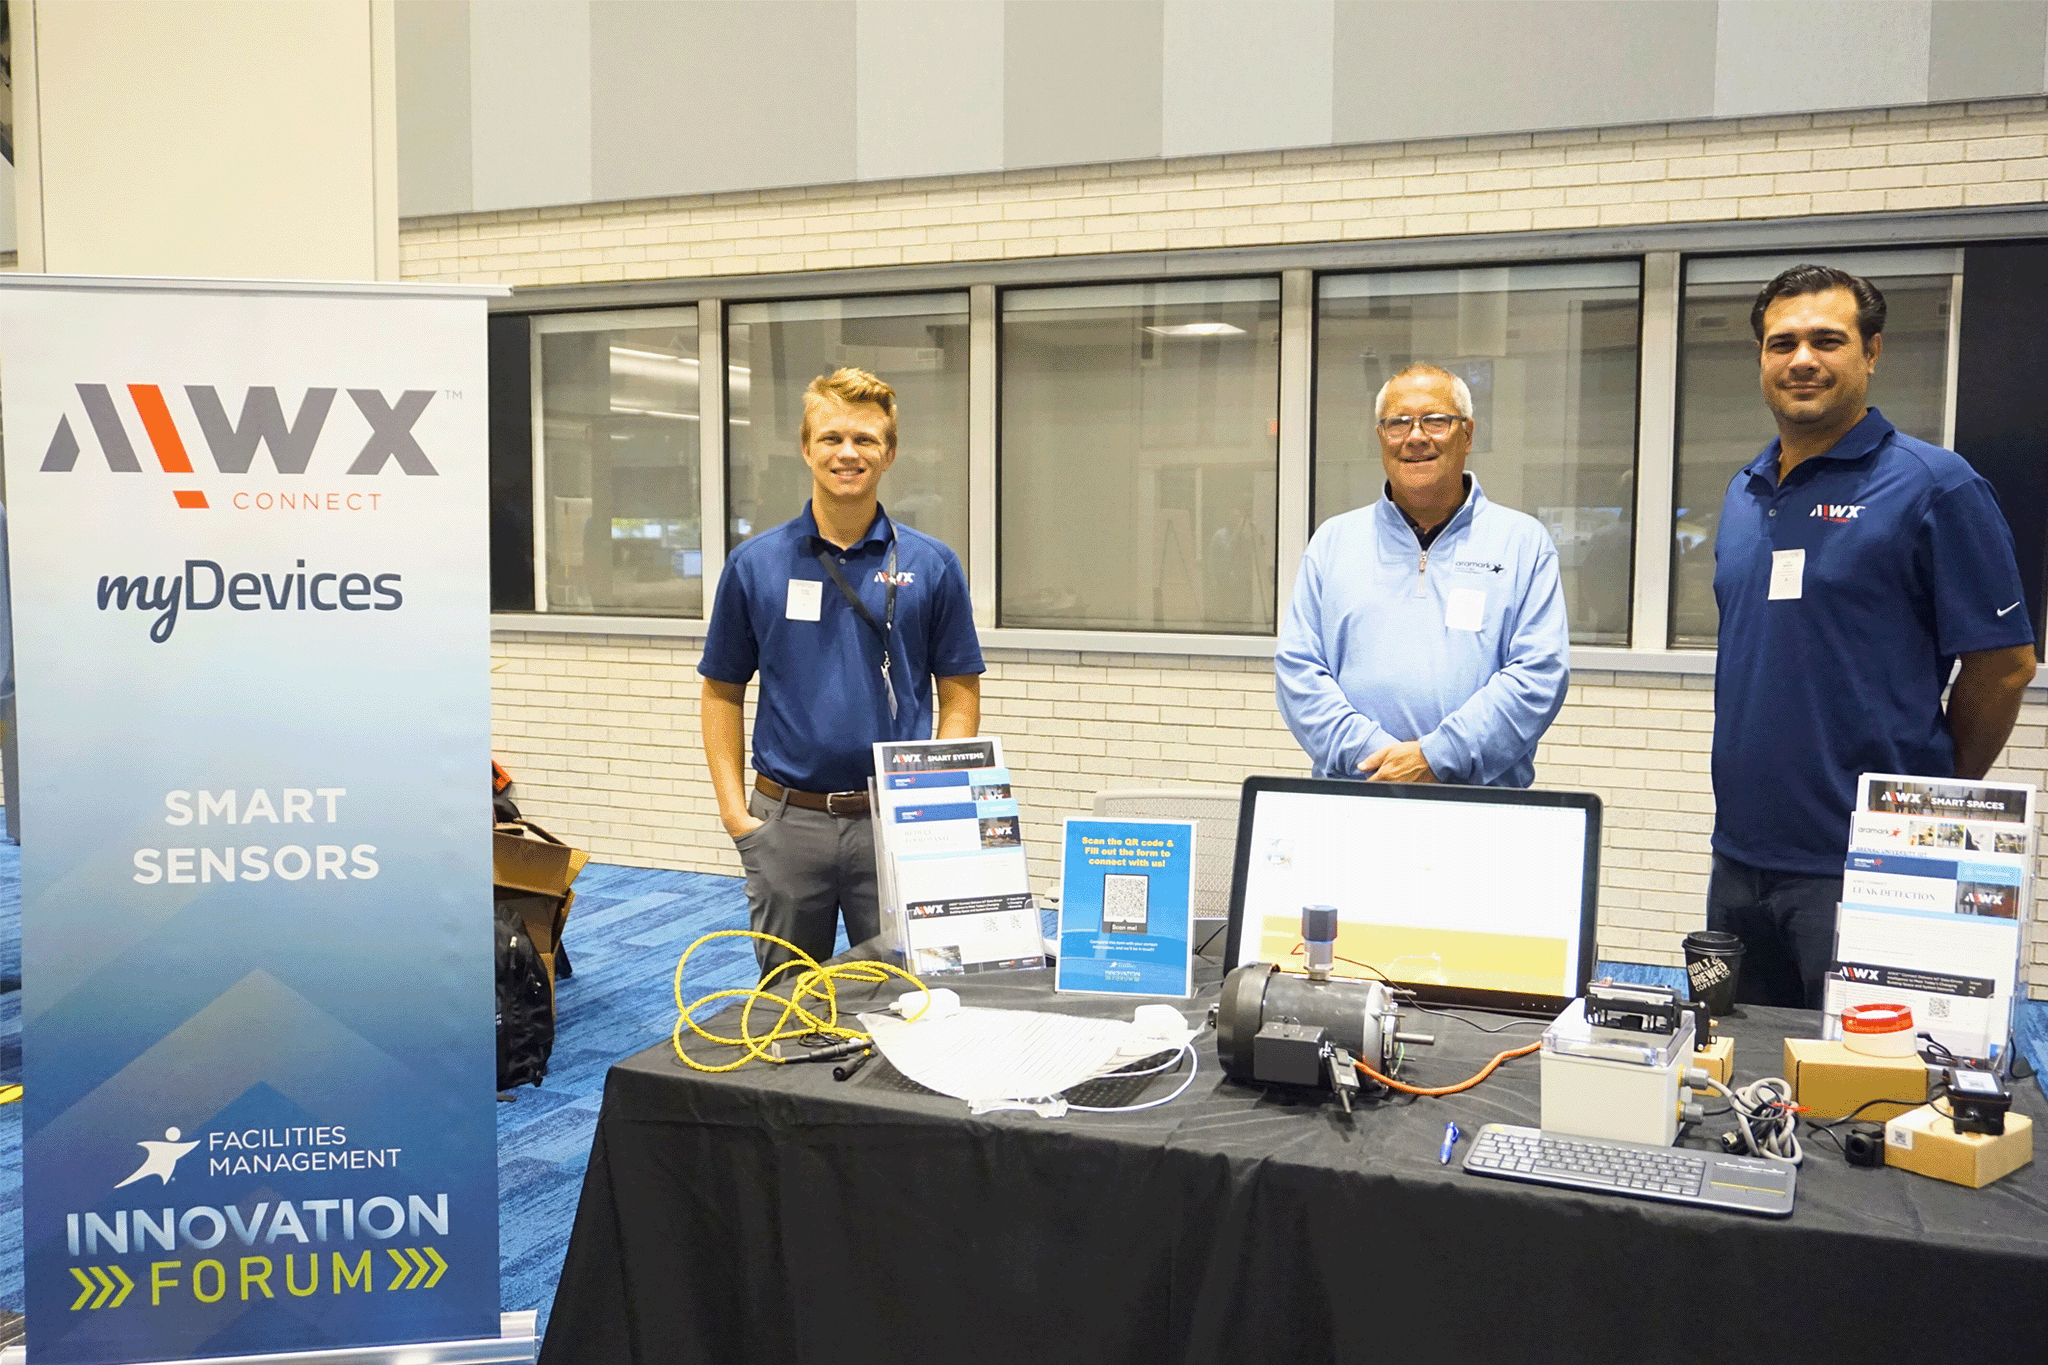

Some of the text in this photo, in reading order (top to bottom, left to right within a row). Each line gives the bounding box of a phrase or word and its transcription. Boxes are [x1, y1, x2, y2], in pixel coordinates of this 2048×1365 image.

[233, 493, 382, 511] CONNECT
[1455, 561, 1490, 569] aramark
[97, 559, 404, 644] myDevices
[927, 754, 952, 763] SMART
[952, 752, 985, 762] SYSTEMS
[164, 787, 347, 827] SMART
[1930, 797, 1965, 808] SMART
[1966, 799, 2005, 811] SPACES
[1858, 827, 1889, 835] aramark
[1081, 836, 1174, 848] Scan the QR code &
[1084, 847, 1099, 855] Fill
[1101, 848, 1117, 856] out
[1119, 848, 1134, 857] the
[1136, 849, 1158, 857] form
[133, 844, 380, 885] SENSORS
[1088, 858, 1126, 866] connect
[1128, 858, 1149, 867] with
[1852, 886, 1936, 901] LEAK DETECTION
[1111, 923, 1126, 931] Scan
[1687, 958, 1711, 976] BUILT
[1690, 961, 1728, 987] BREWED
[1695, 969, 1731, 992] COFFEE CO
[209, 1126, 347, 1152] FACILITIES
[210, 1149, 401, 1177] MANAGEMENT
[66, 1193, 449, 1257] INNOVATION
[151, 1250, 373, 1306] FORUM
